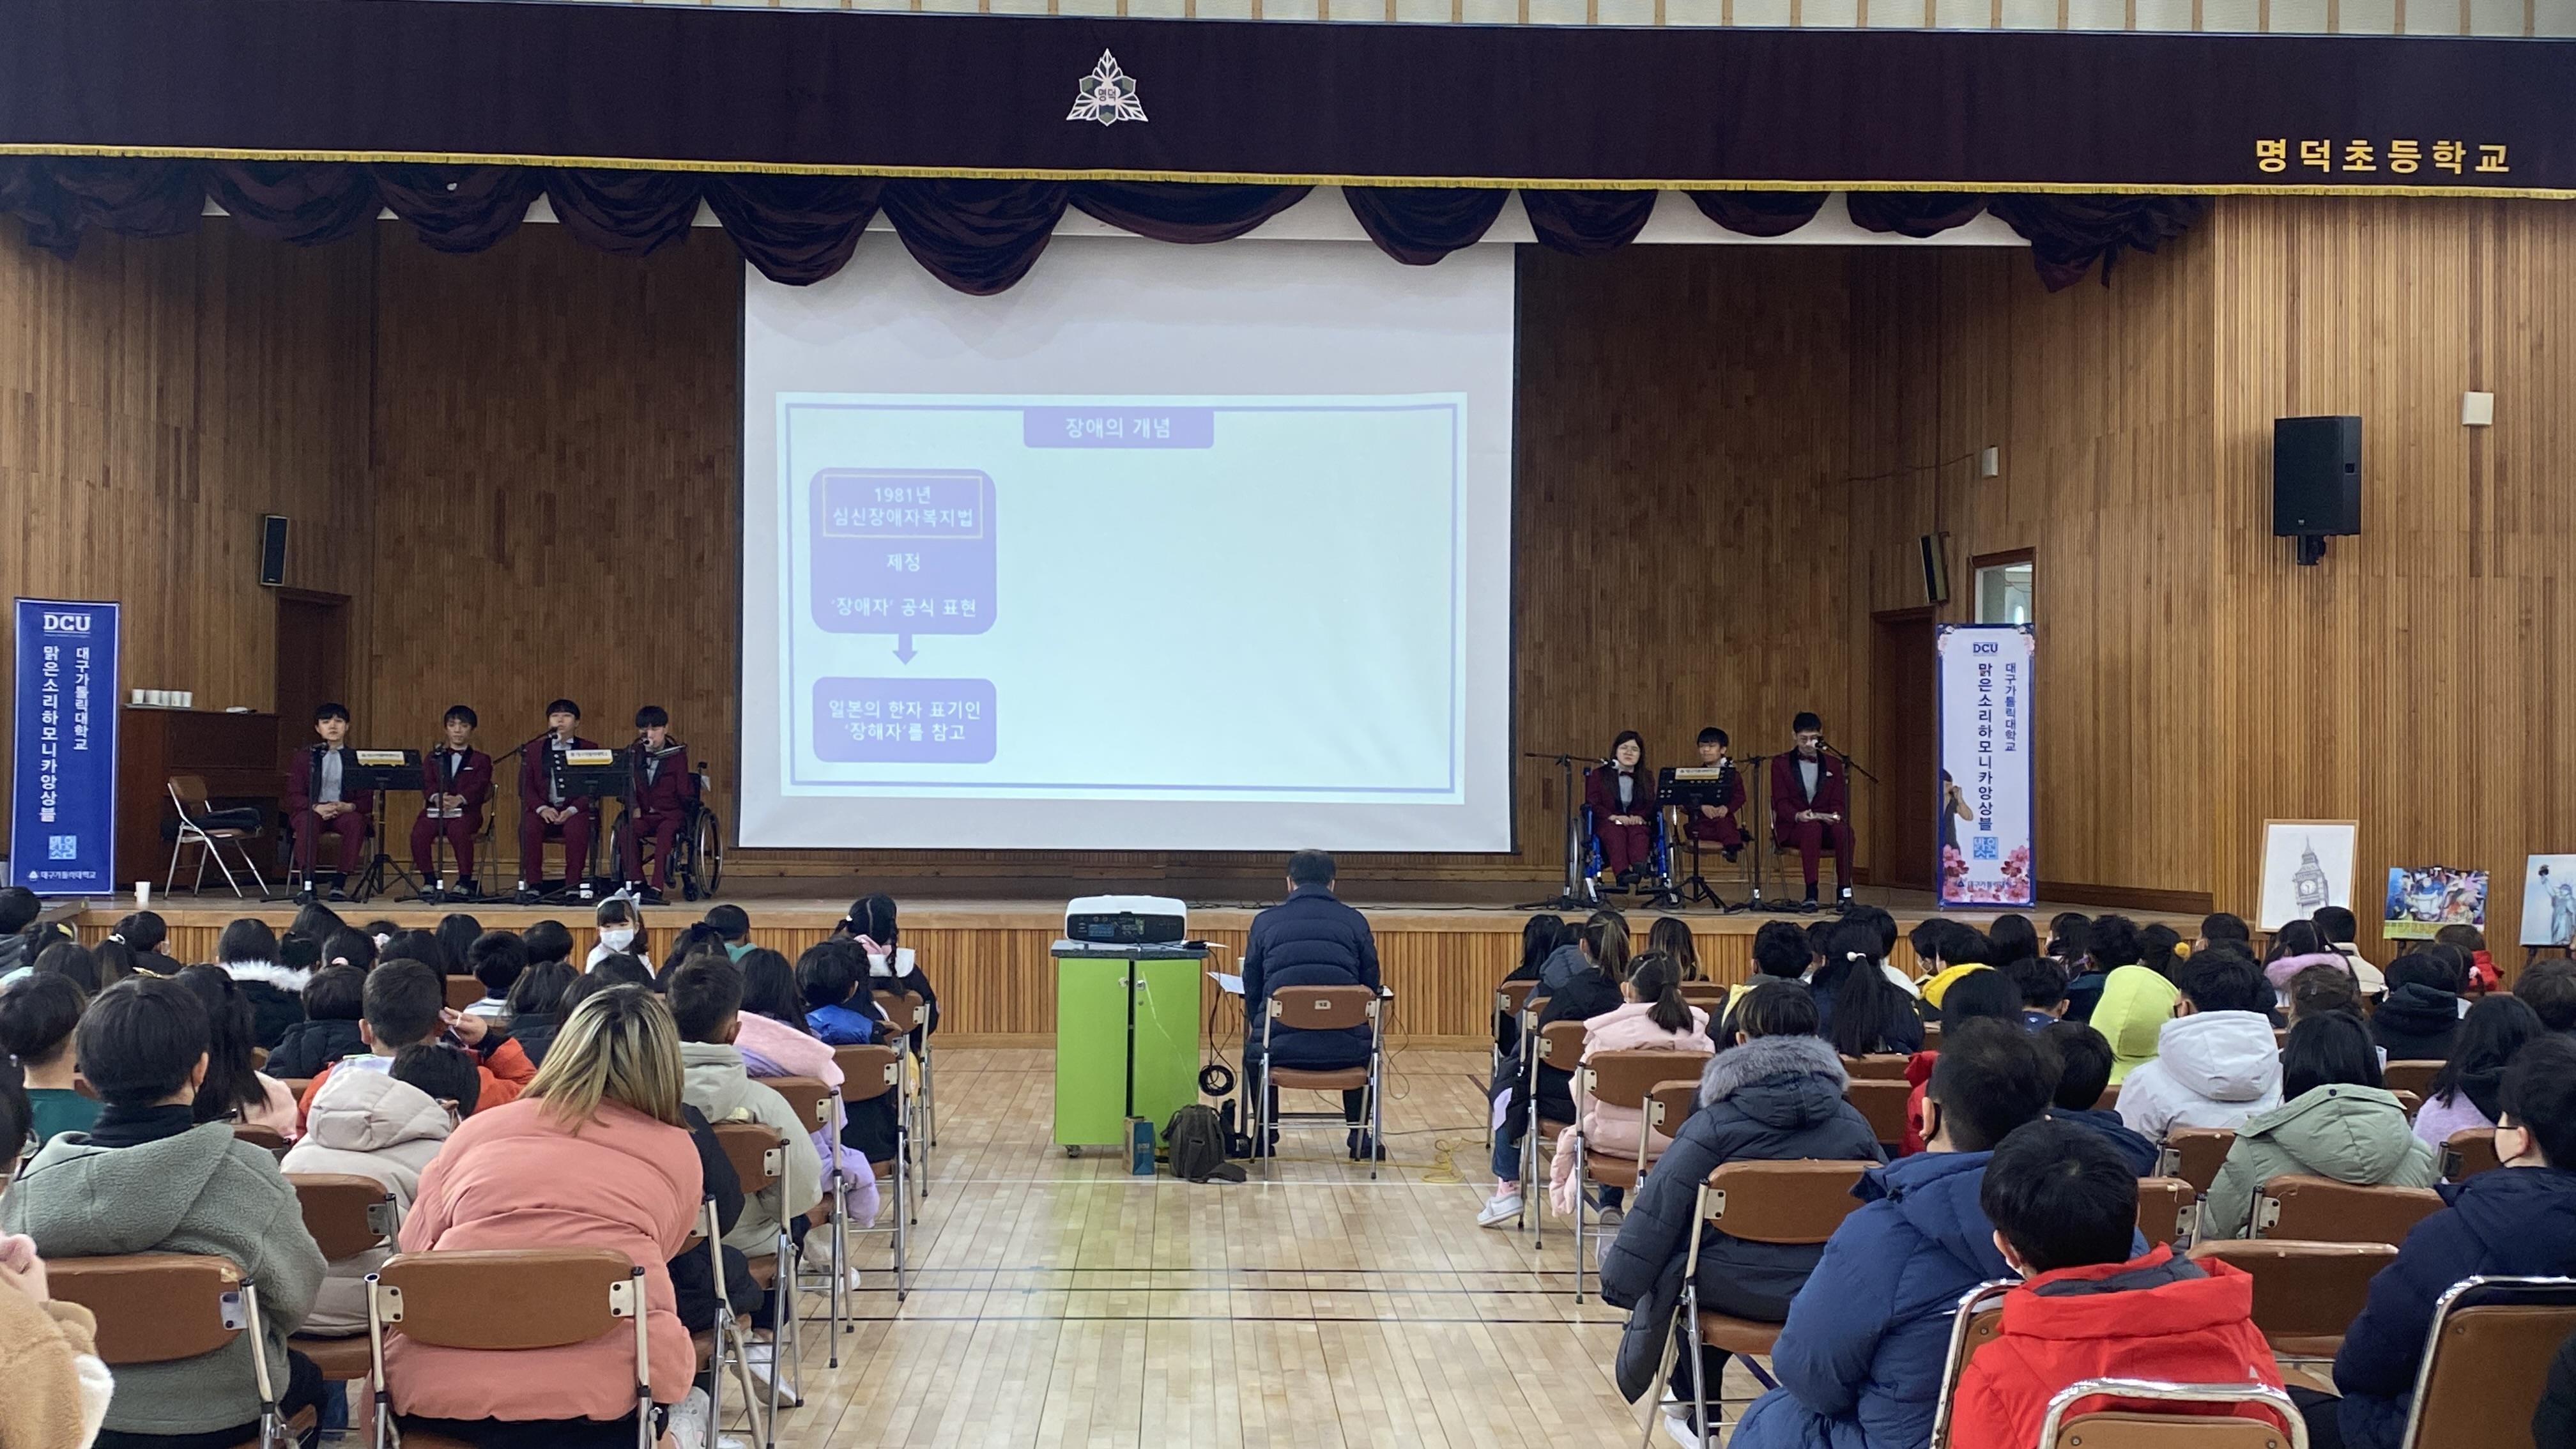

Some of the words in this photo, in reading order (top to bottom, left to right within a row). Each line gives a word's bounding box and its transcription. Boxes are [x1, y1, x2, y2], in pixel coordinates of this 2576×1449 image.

[2256, 138, 2510, 175] 명덕초등학교
[1065, 417, 1123, 439] 장애의
[1133, 417, 1170, 439] 개념
[874, 486, 931, 505] 1981년
[832, 506, 974, 528] 심신장애자복지법
[886, 552, 921, 572] 제정
[901, 597, 935, 617] 공식
[942, 598, 976, 618] 표현
[43, 614, 91, 631] DCU
[1973, 643, 1998, 653] DCU
[829, 699, 880, 719] 일본의
[889, 700, 923, 719] 한자
[930, 700, 981, 720] 표기인
[931, 723, 965, 742] 참고
[1978, 663, 1993, 831] 맑은소리하모니카앙상블
